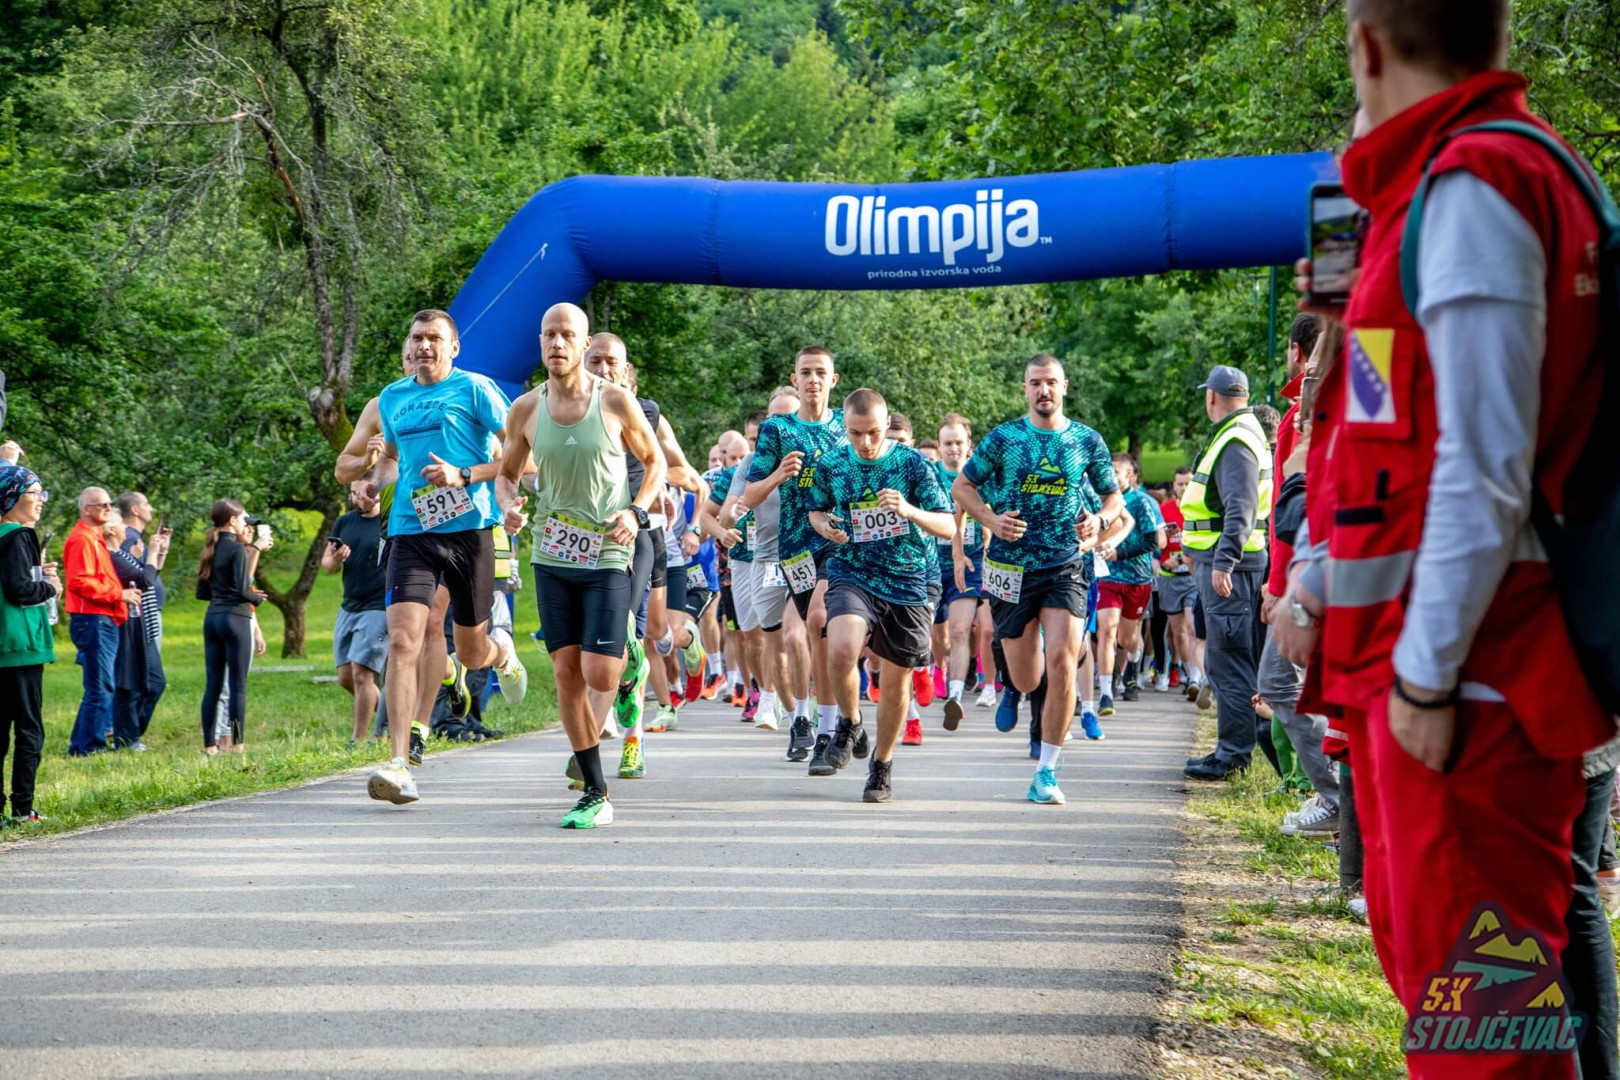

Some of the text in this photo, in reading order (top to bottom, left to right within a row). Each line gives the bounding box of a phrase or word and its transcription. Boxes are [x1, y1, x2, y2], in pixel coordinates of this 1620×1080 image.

[825, 189, 1039, 265] Olimpija
[867, 264, 1002, 280] prirodna izvorska voda
[427, 490, 457, 515] 591
[865, 511, 898, 530] 003
[556, 529, 591, 553] 290
[791, 564, 813, 582] 451
[988, 572, 1011, 591] 606
